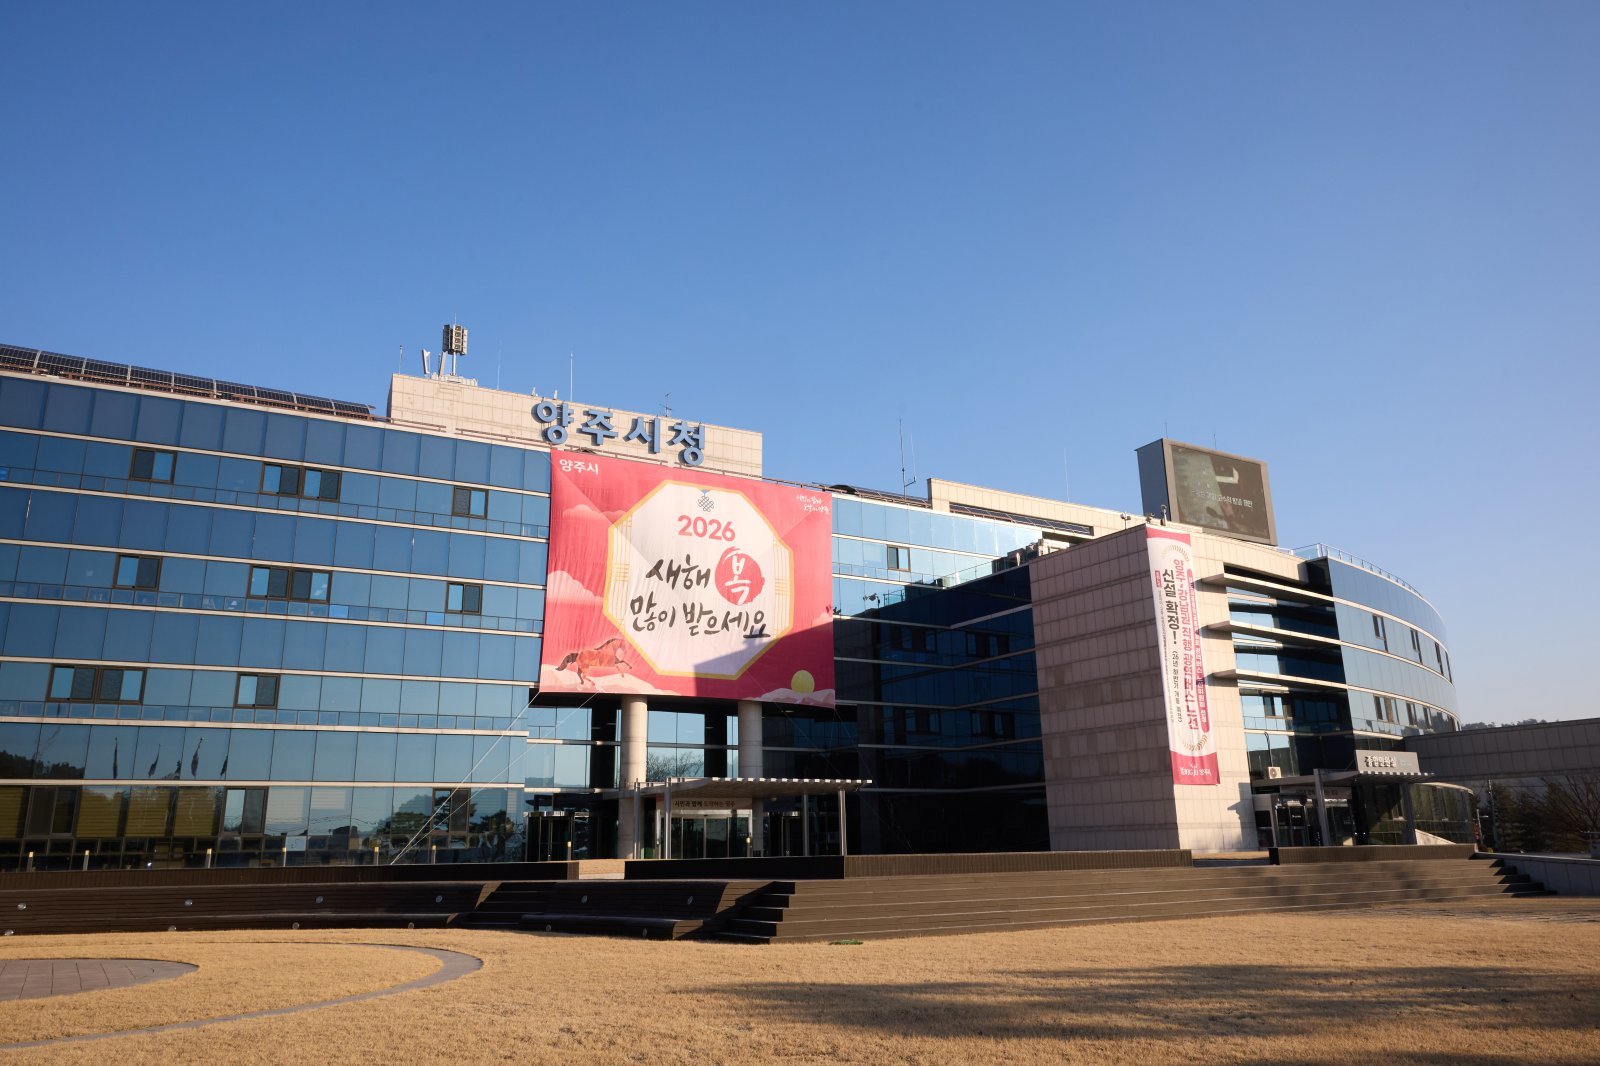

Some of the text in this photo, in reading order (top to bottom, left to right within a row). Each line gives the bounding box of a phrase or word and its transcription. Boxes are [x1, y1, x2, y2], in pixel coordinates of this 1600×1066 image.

[532, 400, 705, 467] 양주시청
[559, 459, 600, 476] 양주시
[677, 514, 736, 542] 2026
[645, 554, 752, 606] 새해 복
[1162, 568, 1177, 598] 신설
[630, 591, 771, 639] 많이 받으세요
[1165, 601, 1180, 645] 확정!
